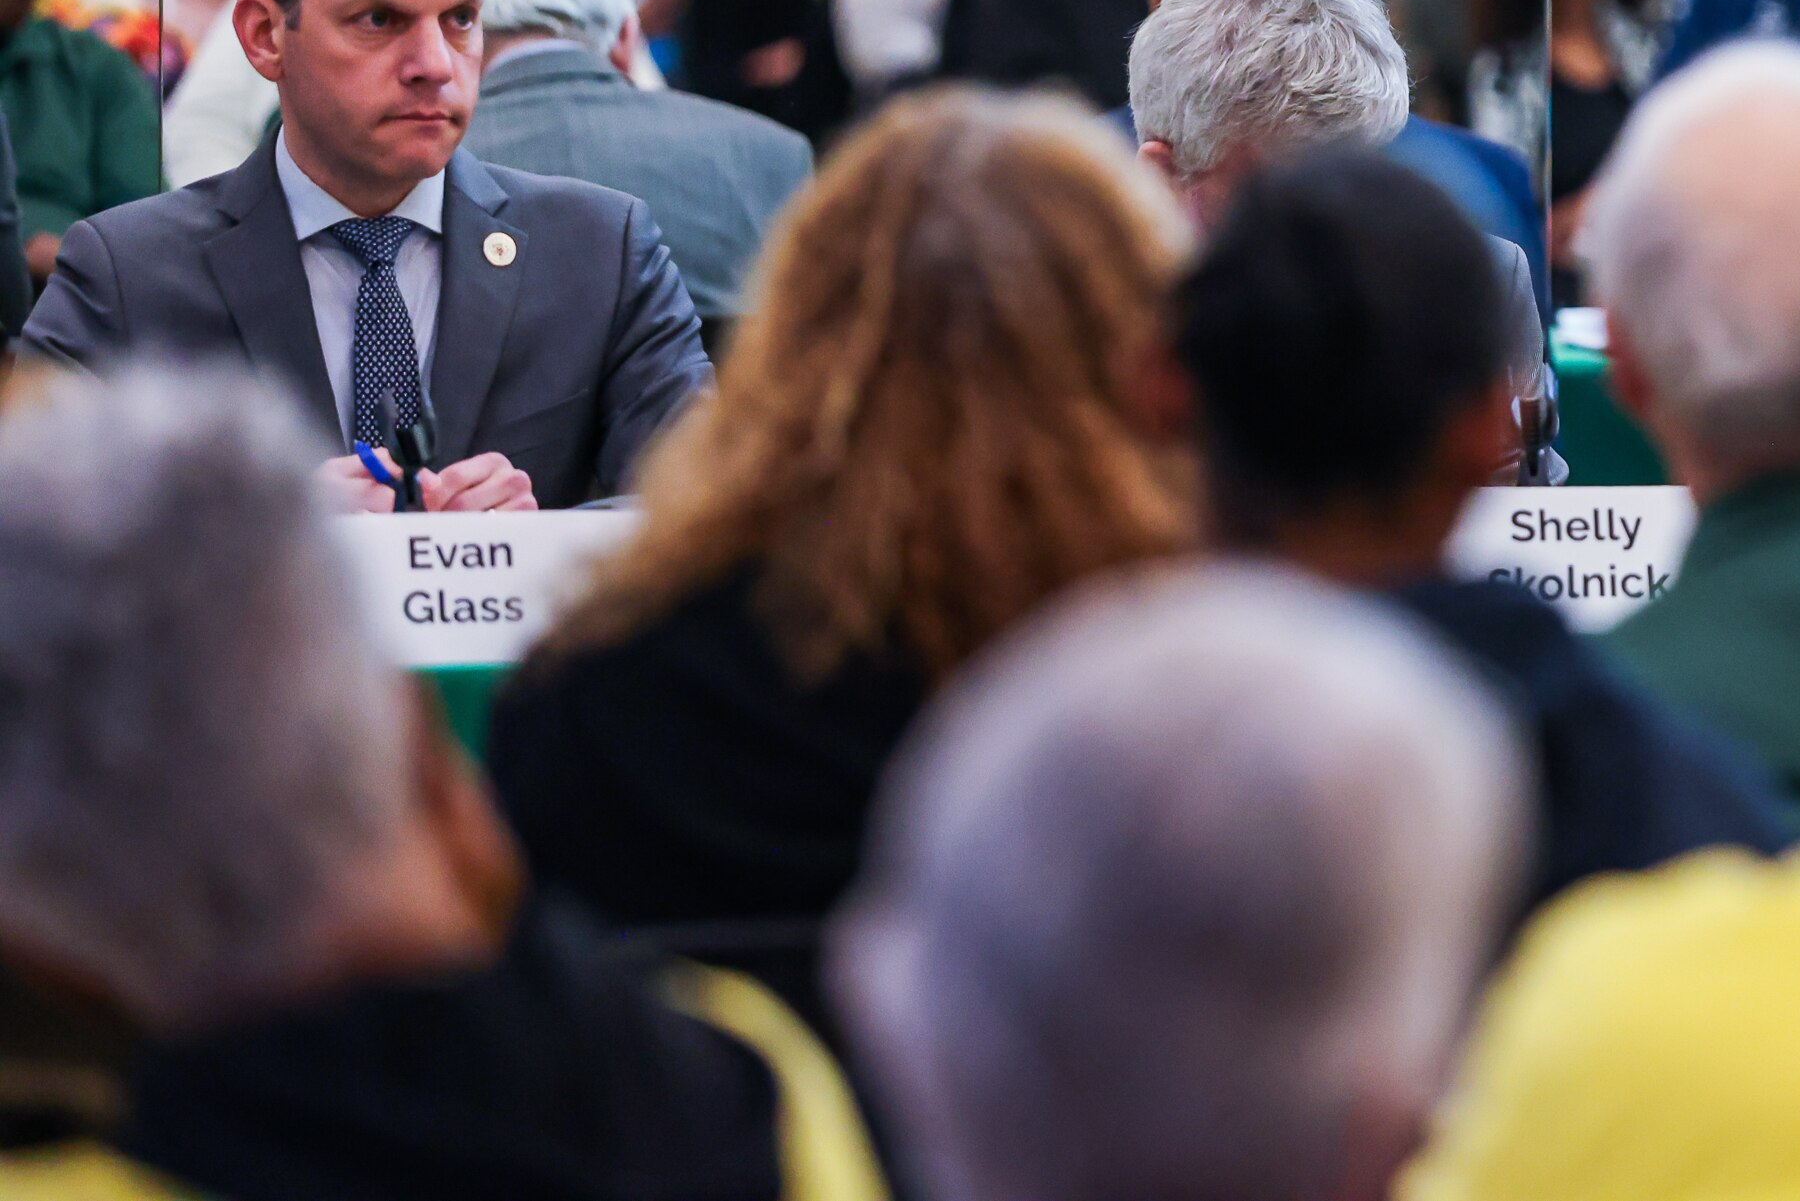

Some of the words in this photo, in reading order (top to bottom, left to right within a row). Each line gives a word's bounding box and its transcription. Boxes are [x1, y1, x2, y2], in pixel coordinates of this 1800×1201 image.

[1511, 507, 1642, 551] Shelly
[408, 535, 513, 569] Evan
[403, 589, 524, 624] Glass
